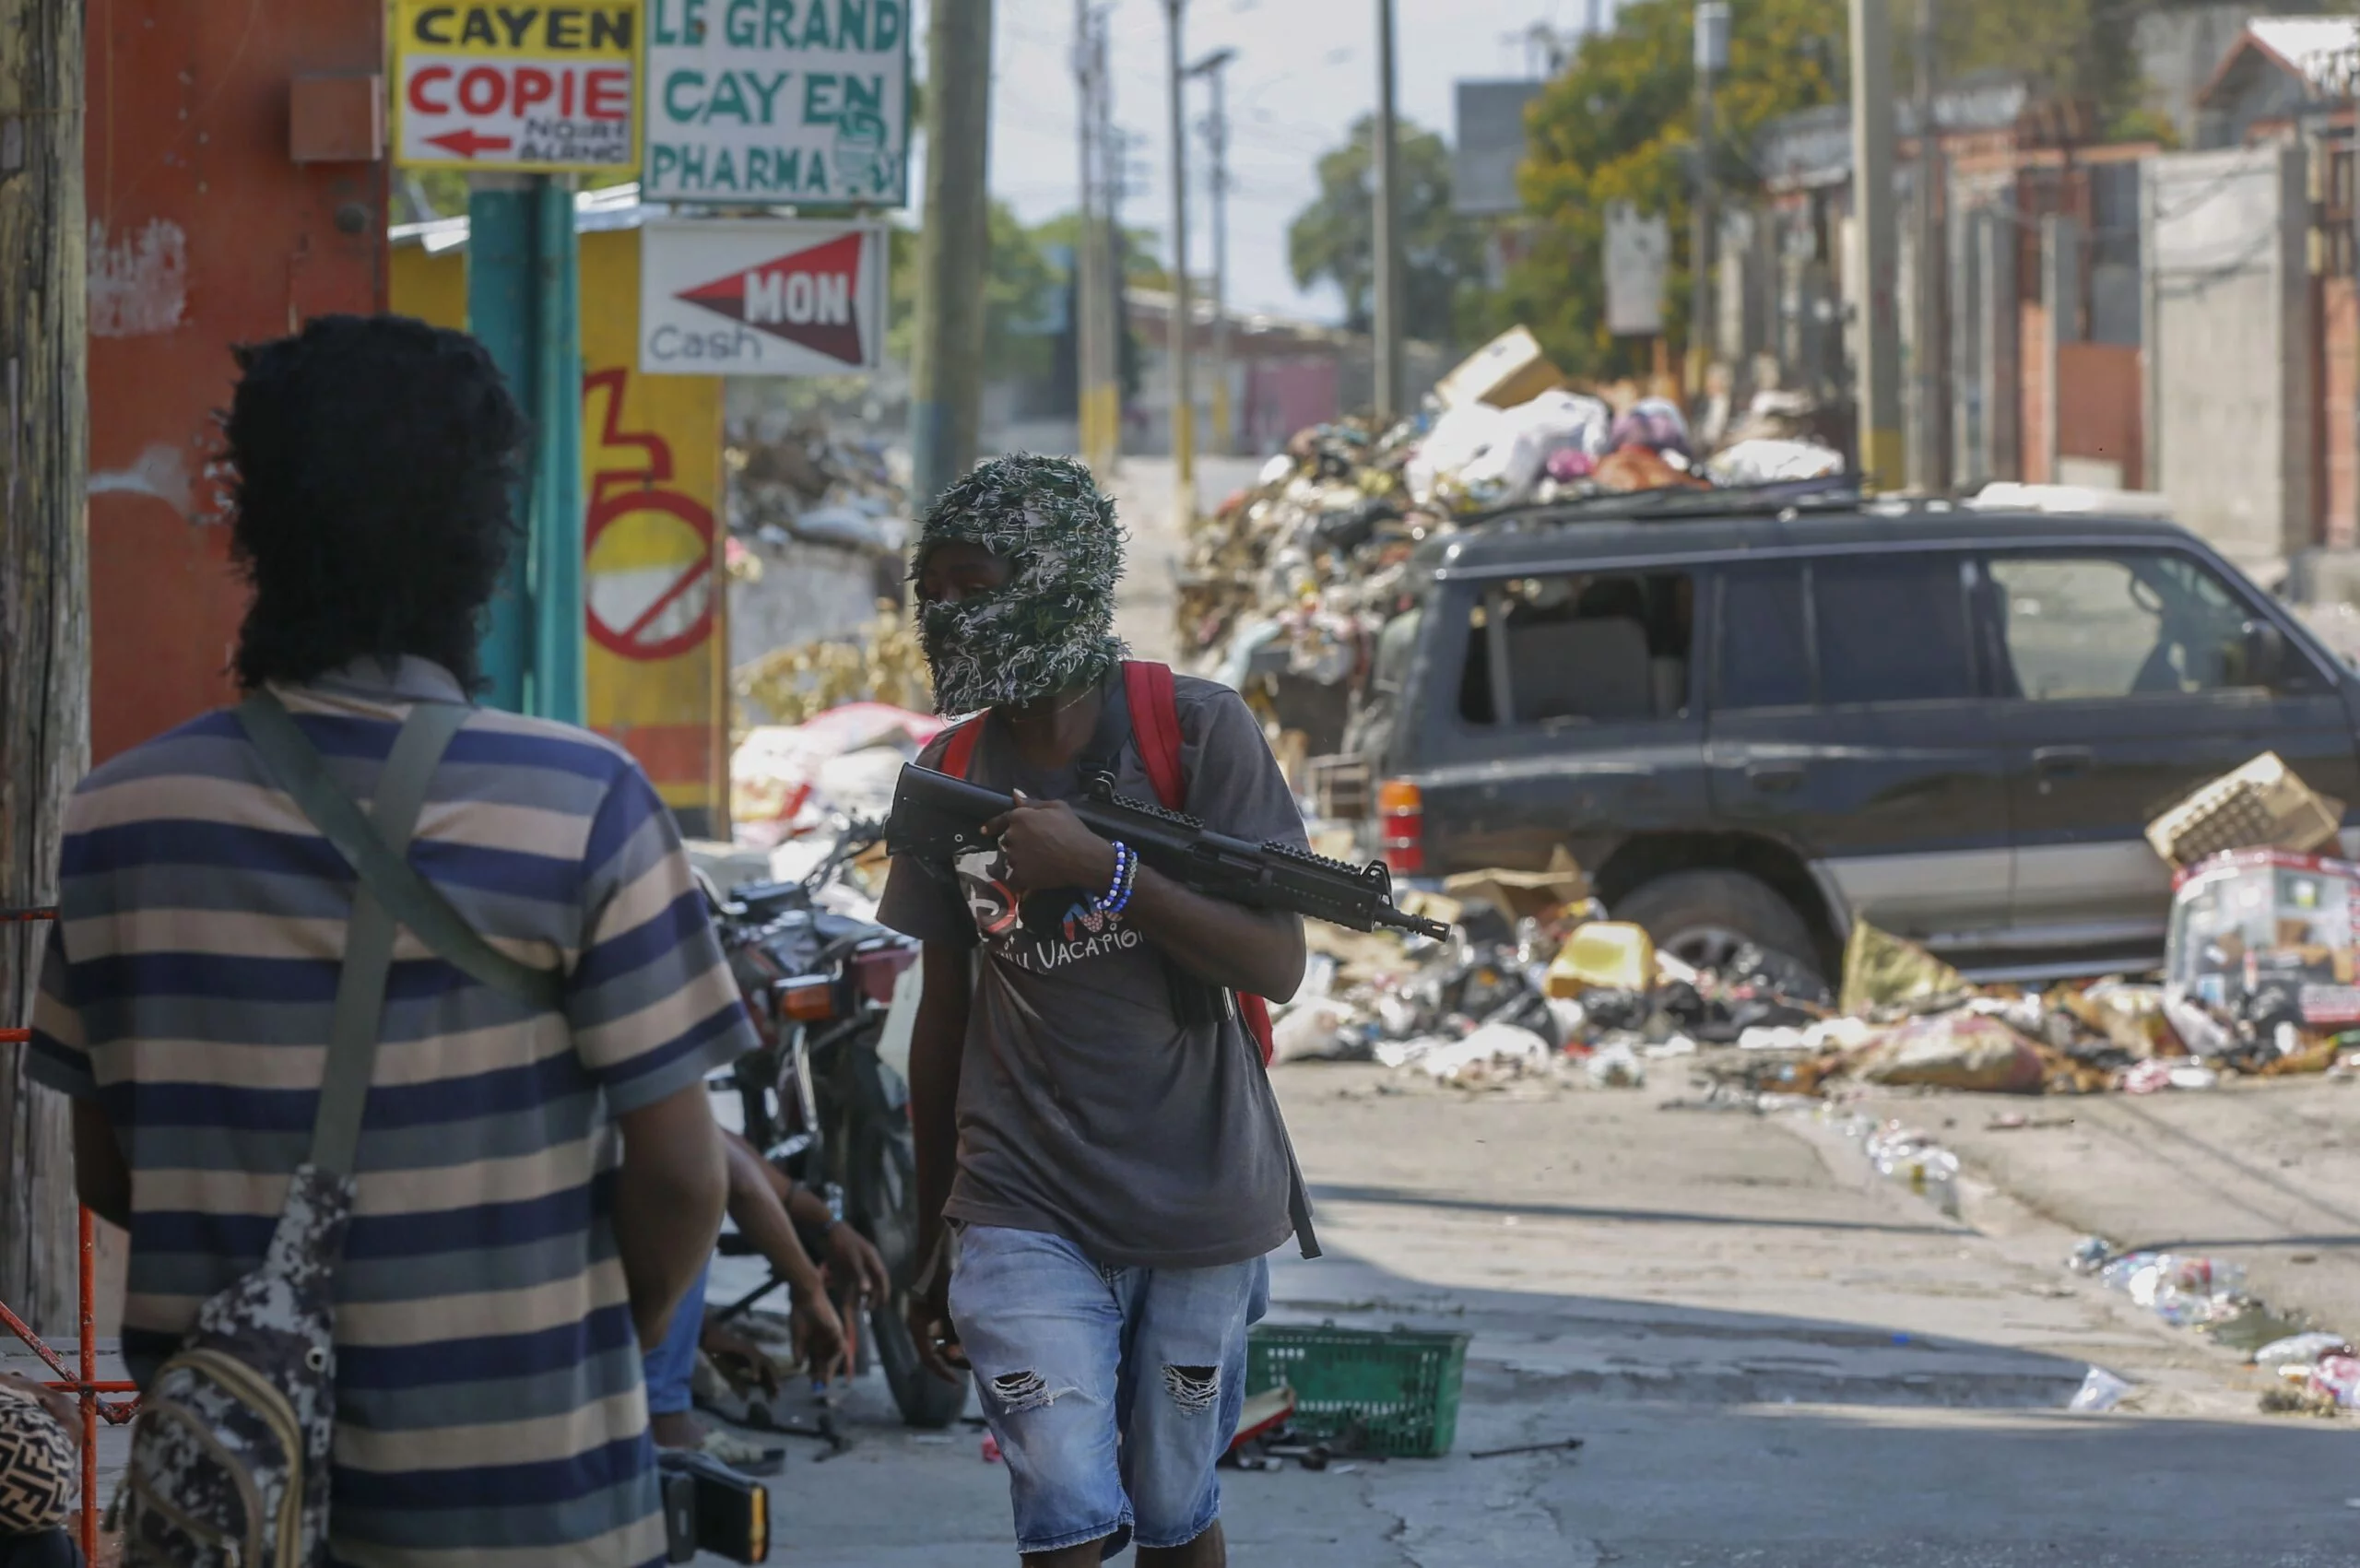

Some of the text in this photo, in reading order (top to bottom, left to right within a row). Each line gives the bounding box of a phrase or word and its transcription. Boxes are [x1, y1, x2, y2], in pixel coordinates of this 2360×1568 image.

[415, 6, 634, 50] CAYEN
[654, 0, 900, 51] LE GRAND
[408, 67, 629, 119] COPIE
[664, 71, 883, 124] CAYEN
[744, 271, 850, 324] MON
[651, 325, 761, 360] Cash
